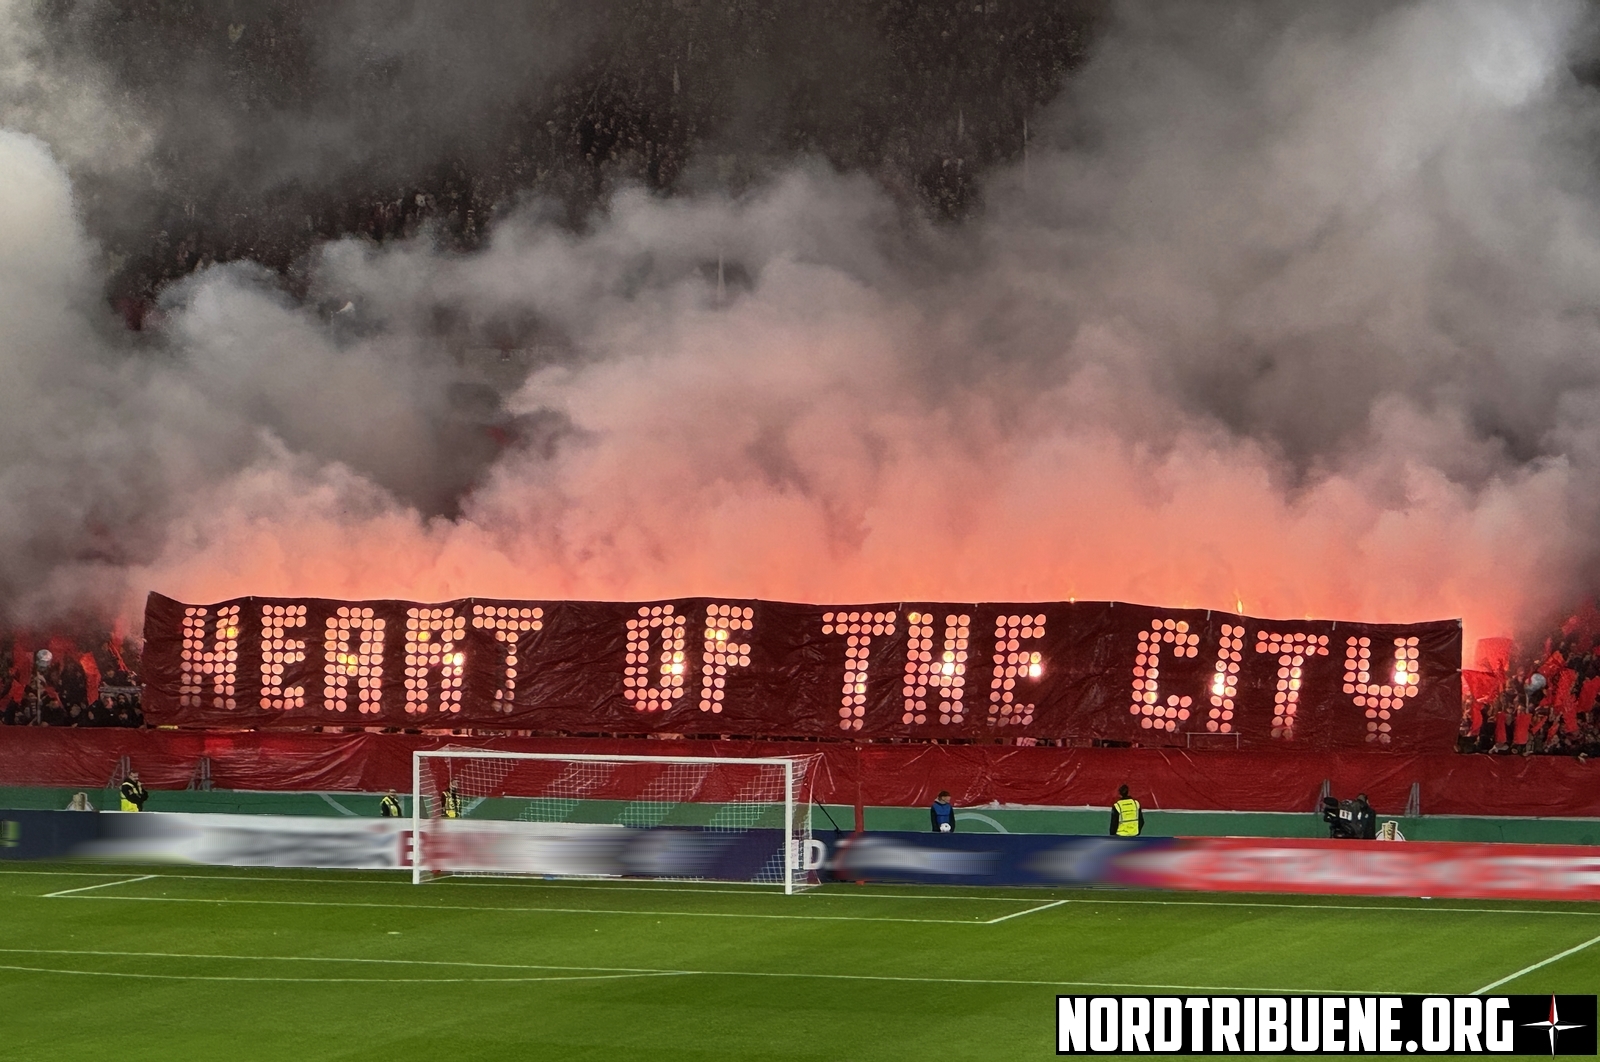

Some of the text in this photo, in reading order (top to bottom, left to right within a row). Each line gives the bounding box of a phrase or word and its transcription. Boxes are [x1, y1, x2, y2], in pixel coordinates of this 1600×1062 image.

[180, 605, 1420, 743] HEART OF THE CITY
